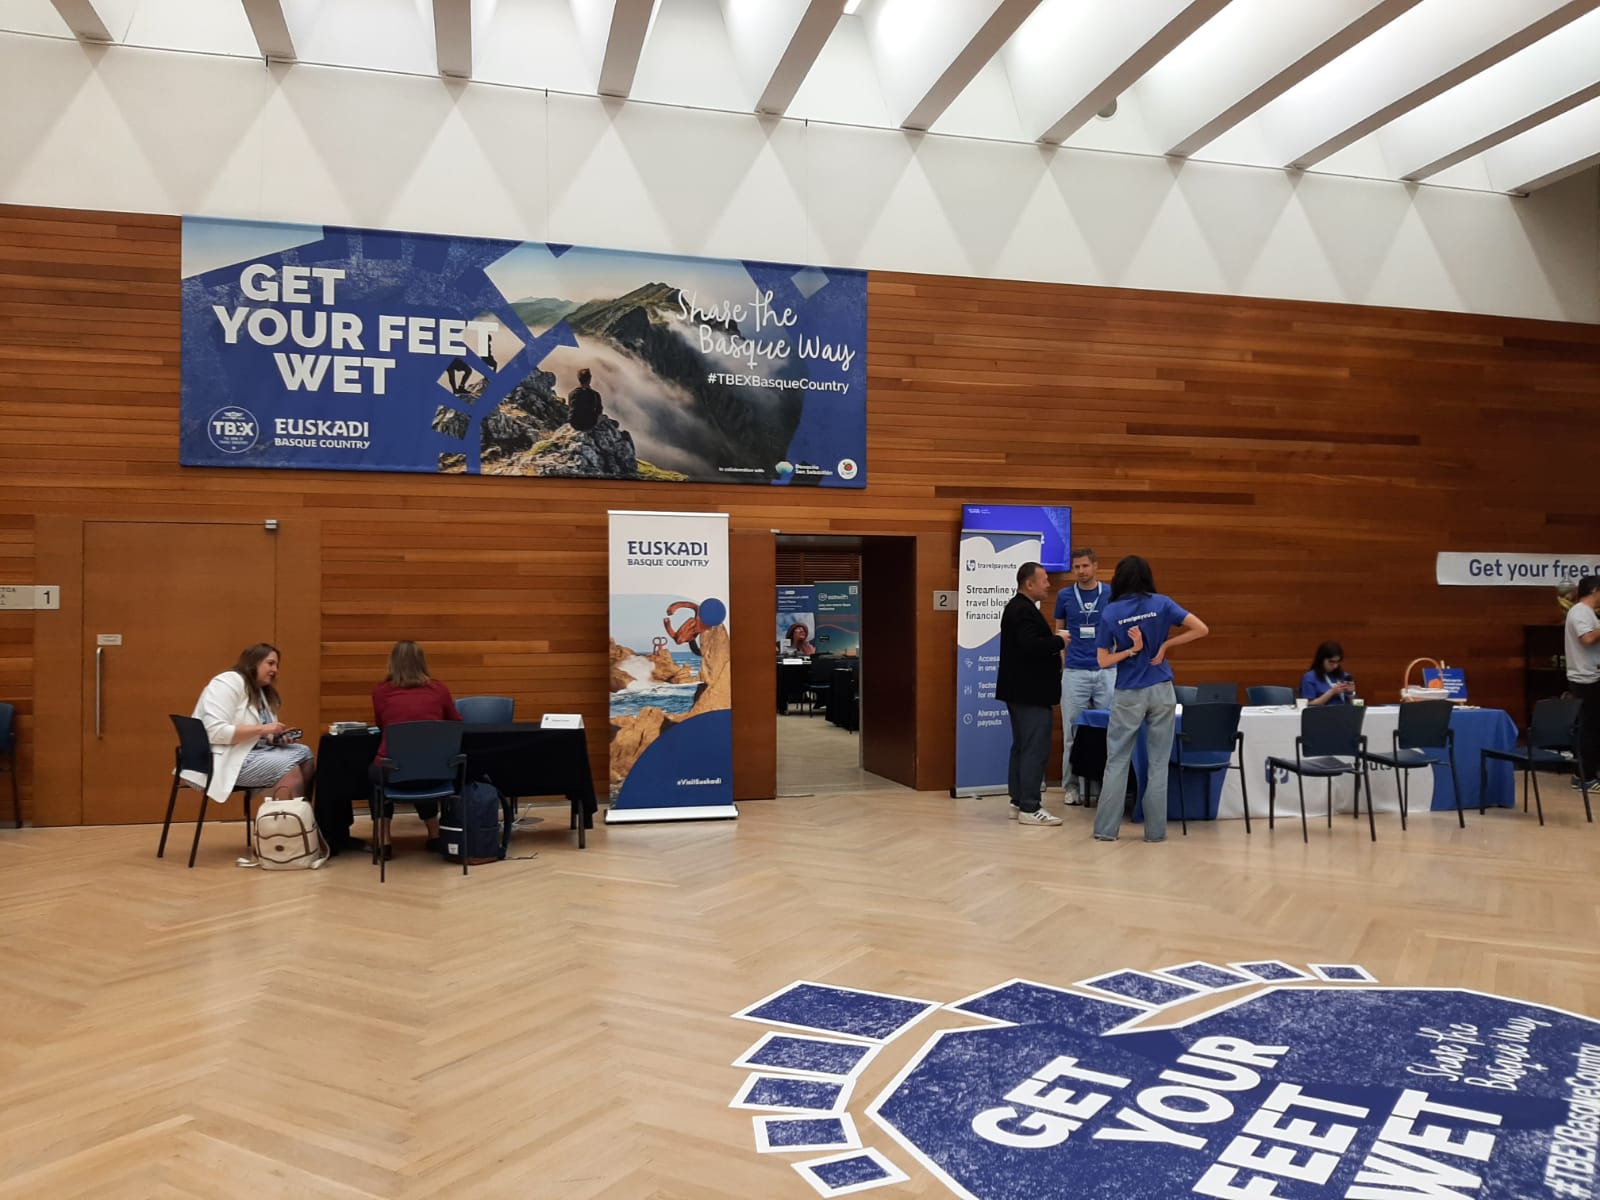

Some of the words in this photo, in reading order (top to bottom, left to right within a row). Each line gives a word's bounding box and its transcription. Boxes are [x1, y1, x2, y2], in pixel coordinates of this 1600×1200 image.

[240, 263, 346, 305] GET
[676, 288, 748, 328] Share
[748, 288, 797, 332] the
[212, 305, 365, 351] YOUR
[379, 315, 499, 357] FEET
[700, 324, 791, 370] Basque
[798, 333, 855, 371] Way
[273, 352, 396, 395] WET
[707, 372, 849, 395] #TBEXBasqueCountry
[212, 421, 254, 436] TBEX
[274, 418, 369, 437] EUSKADI
[274, 438, 317, 448] BASQUE
[319, 439, 370, 449] COUNTRY
[627, 541, 708, 556] EUSKADI
[627, 558, 664, 567] BASQUE
[666, 559, 710, 567] COUNTRY
[1469, 558, 1503, 577] Get
[1507, 563, 1549, 581] your
[1552, 560, 1589, 578] free
[43, 590, 50, 604] 1
[939, 594, 948, 607] 2
[966, 585, 1009, 594] Streamline
[966, 598, 989, 607] travel
[991, 598, 1009, 608] blog
[966, 610, 1001, 620] financial
[1406, 1044, 1479, 1082] Share
[1463, 1043, 1549, 1091] Basque
[971, 1055, 1132, 1149] GET
[1092, 1036, 1290, 1150] YOUR
[1192, 1082, 1370, 1200] FEET
[1344, 1088, 1503, 1200] WET
